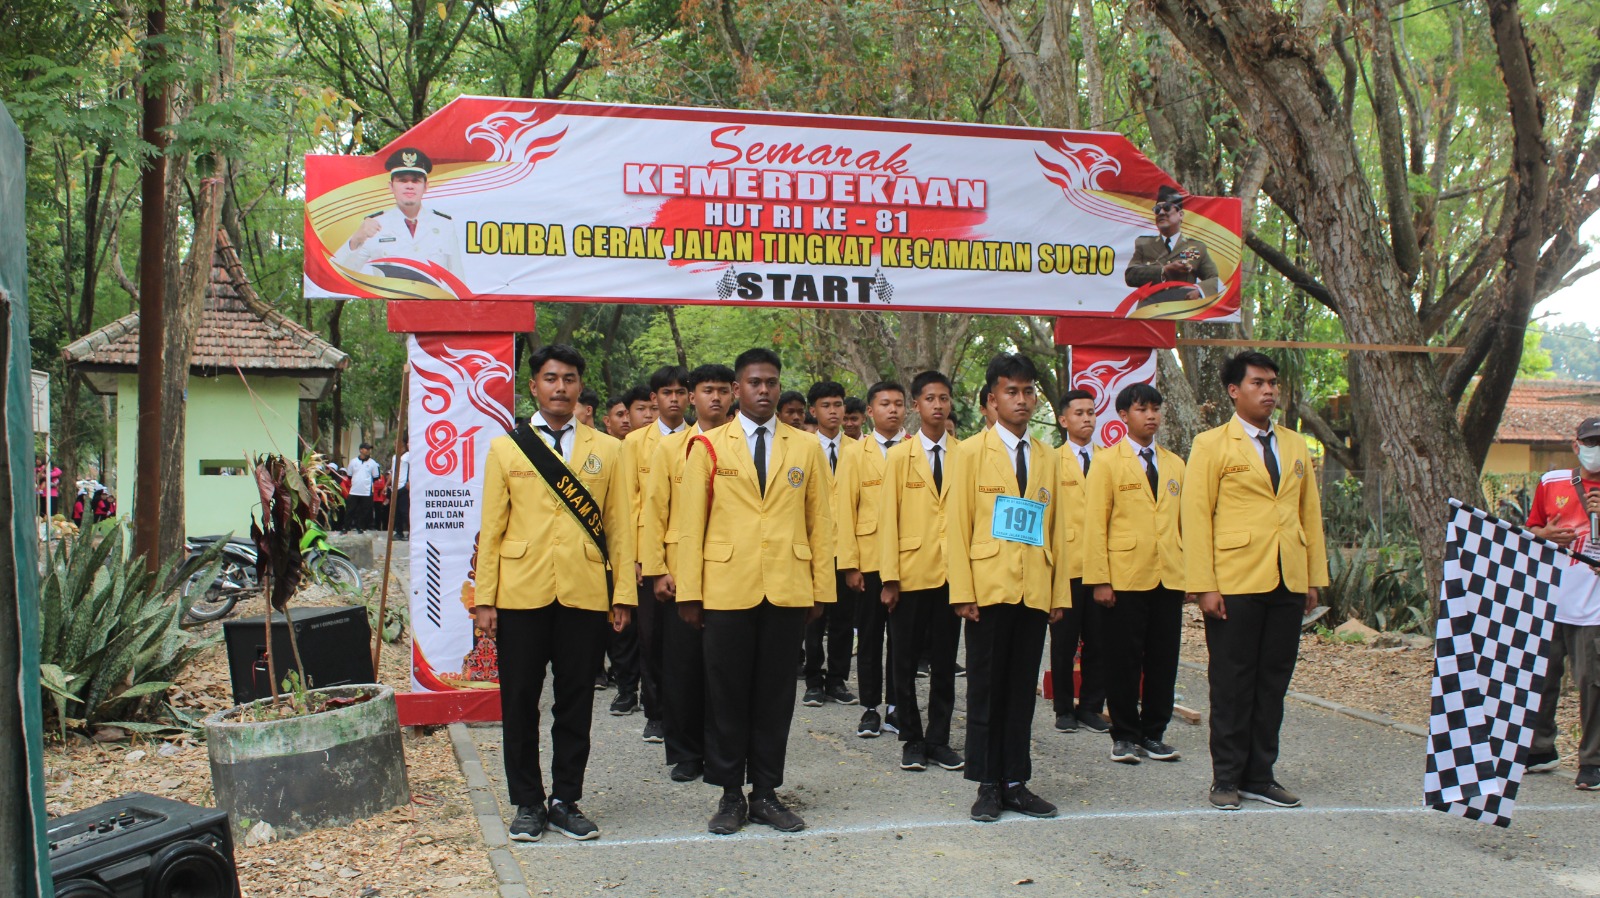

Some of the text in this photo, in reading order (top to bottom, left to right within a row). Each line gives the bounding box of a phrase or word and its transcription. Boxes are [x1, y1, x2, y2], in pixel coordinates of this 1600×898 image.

[707, 125, 913, 175] Semarak
[624, 162, 987, 210] KEMERDEKAAN
[704, 202, 763, 227] HUT
[773, 205, 802, 229] RI
[813, 206, 847, 231] KE
[875, 209, 908, 233] 81
[466, 221, 1115, 275] LOMBA GERAK JALAN TINGKAT KECAMATAN SUGIO
[736, 272, 876, 303] START
[425, 419, 484, 484] 81
[425, 489, 471, 497] INDONESIA
[425, 500, 474, 508] BERDAULAT
[425, 511, 444, 519] ADIL
[425, 521, 464, 529] MAKMUR
[1003, 507, 1037, 533] 197
